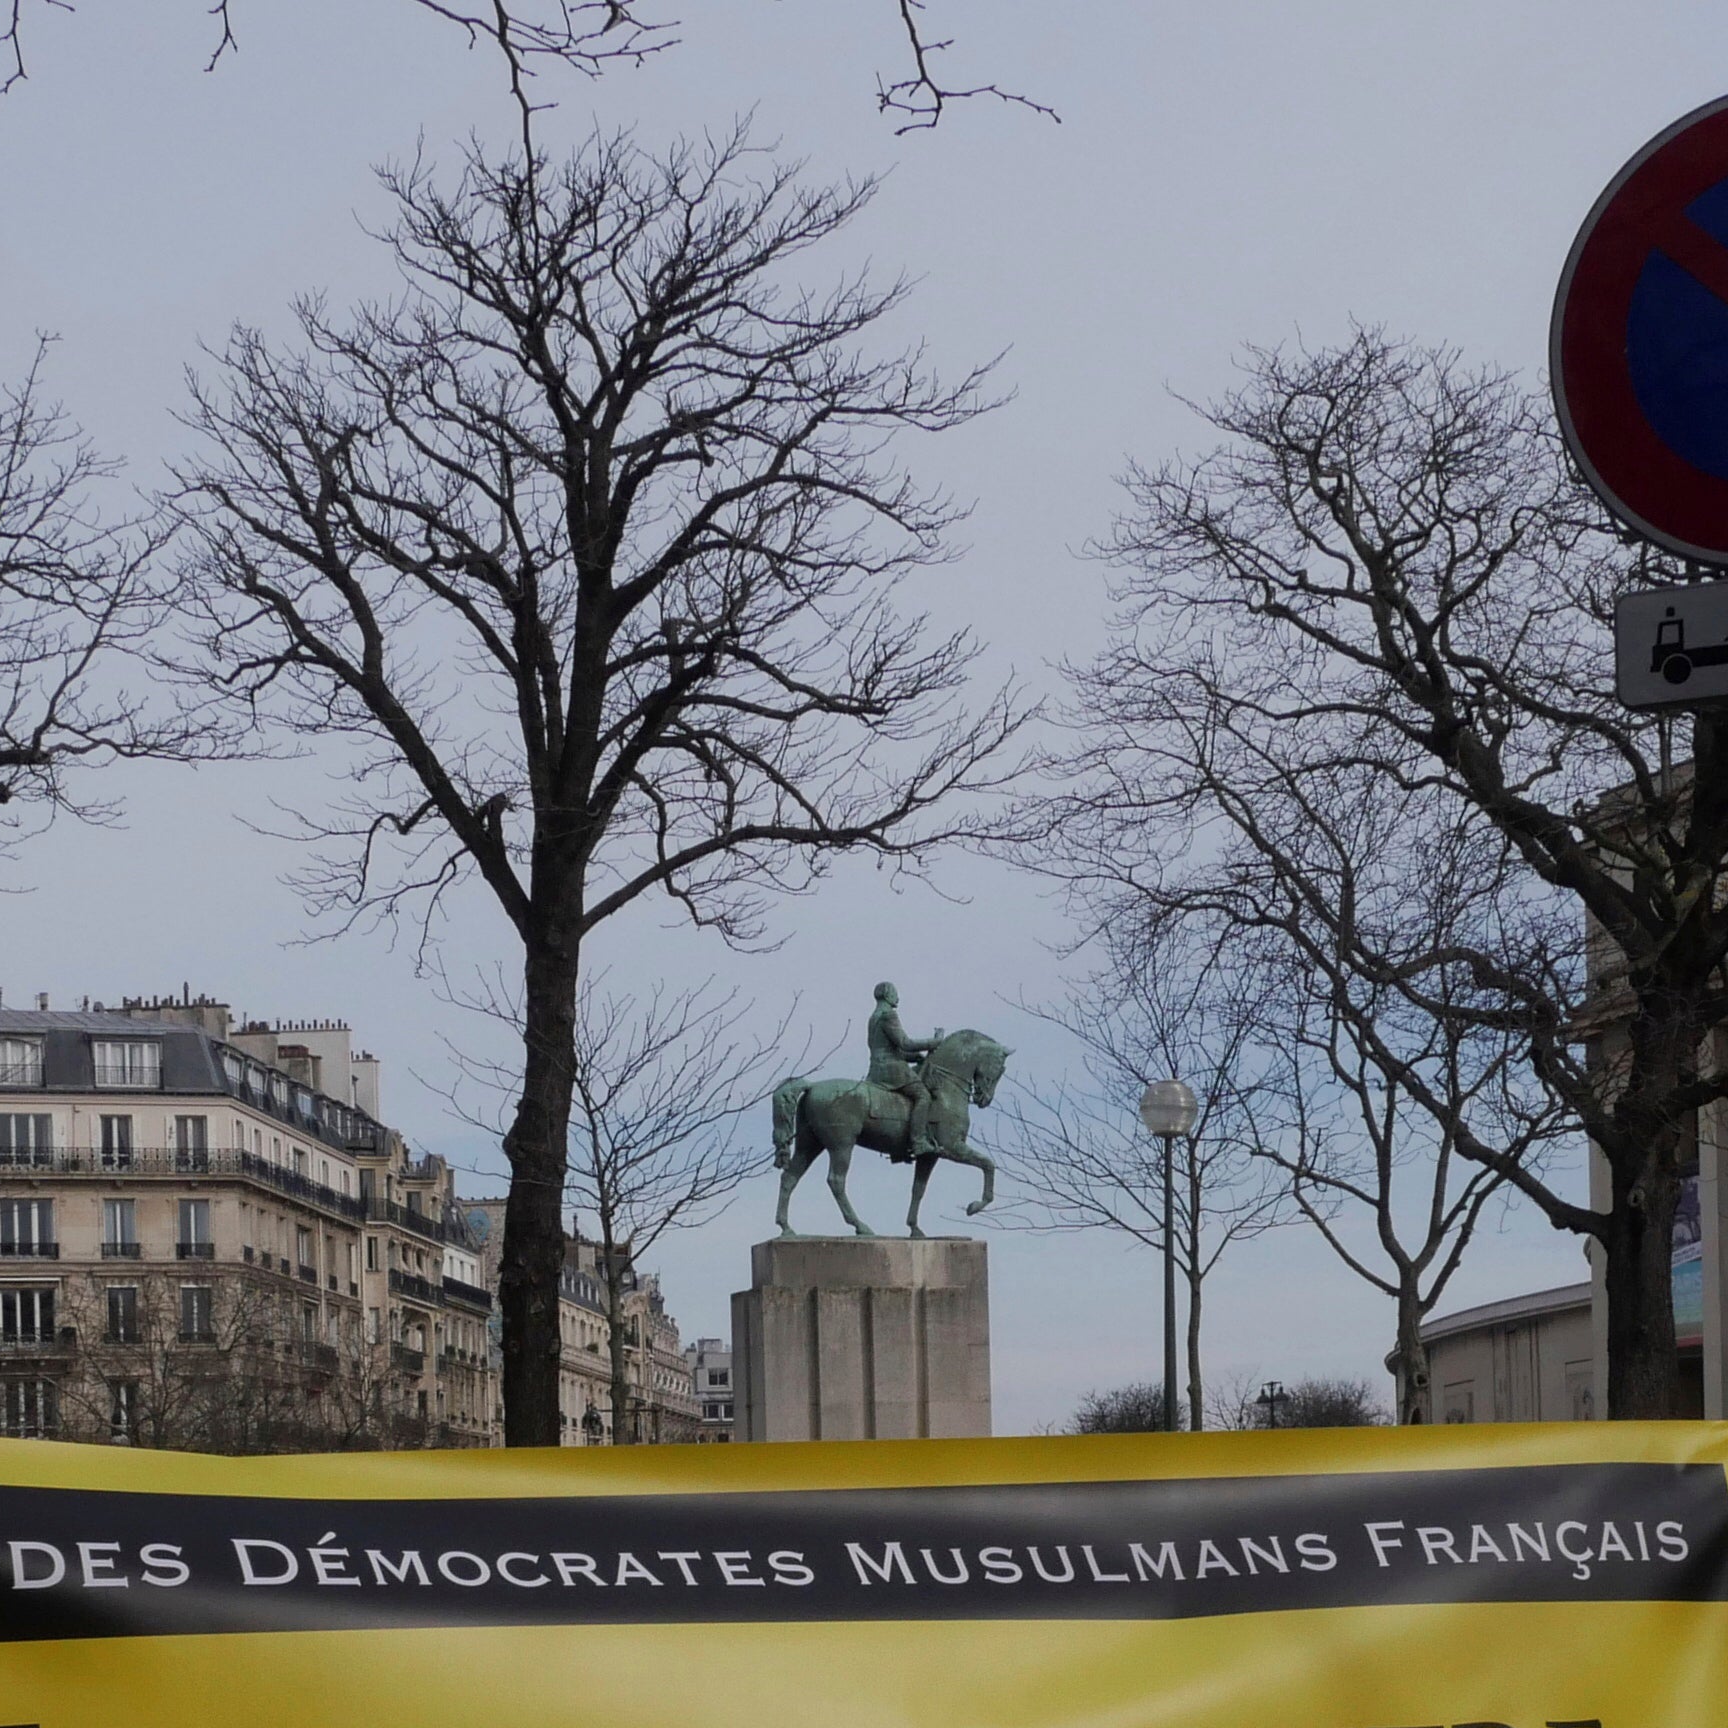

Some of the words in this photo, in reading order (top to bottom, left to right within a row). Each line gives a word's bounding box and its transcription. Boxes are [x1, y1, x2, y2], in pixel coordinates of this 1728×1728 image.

[10, 1538, 191, 1590] DES
[229, 1530, 816, 1588] DÉMOCRATES
[844, 1531, 1340, 1587] MUSULMANS
[1362, 1518, 1692, 1581] FRANÇAIS
